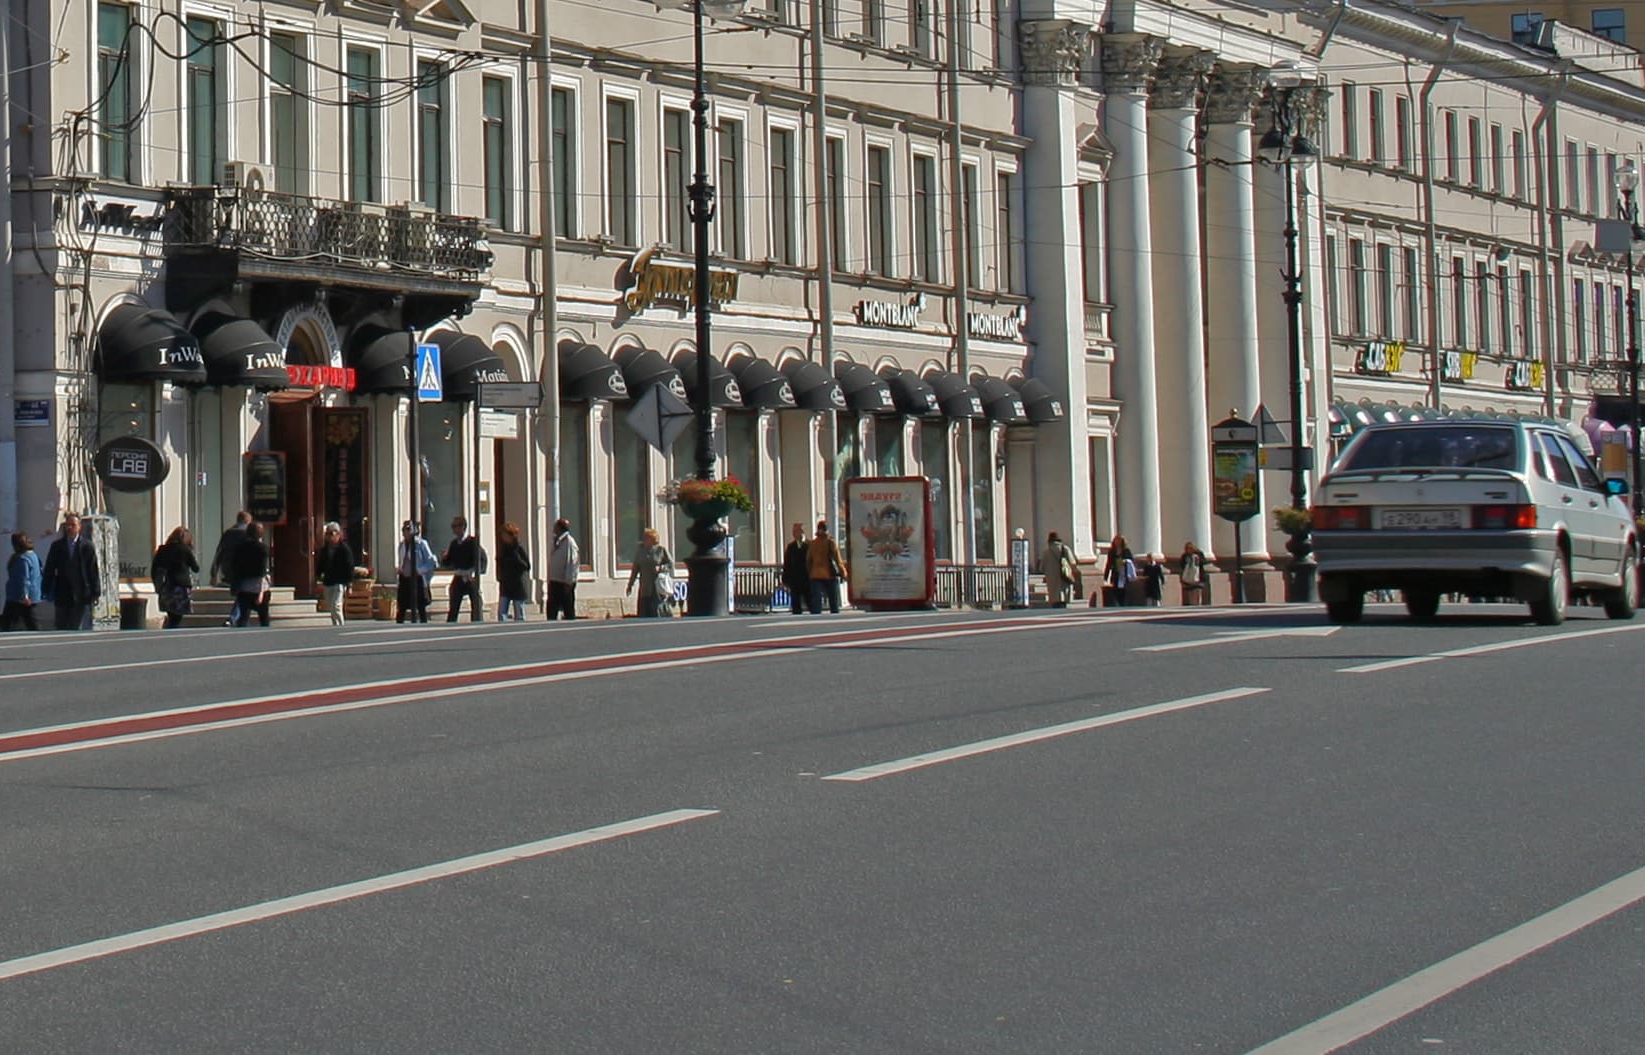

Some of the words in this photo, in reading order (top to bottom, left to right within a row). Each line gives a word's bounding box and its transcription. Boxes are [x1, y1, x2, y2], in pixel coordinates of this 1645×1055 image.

[863, 299, 920, 327] MONTBLANC
[971, 312, 1021, 337] MONTBLANC
[110, 458, 148, 474] LAB
